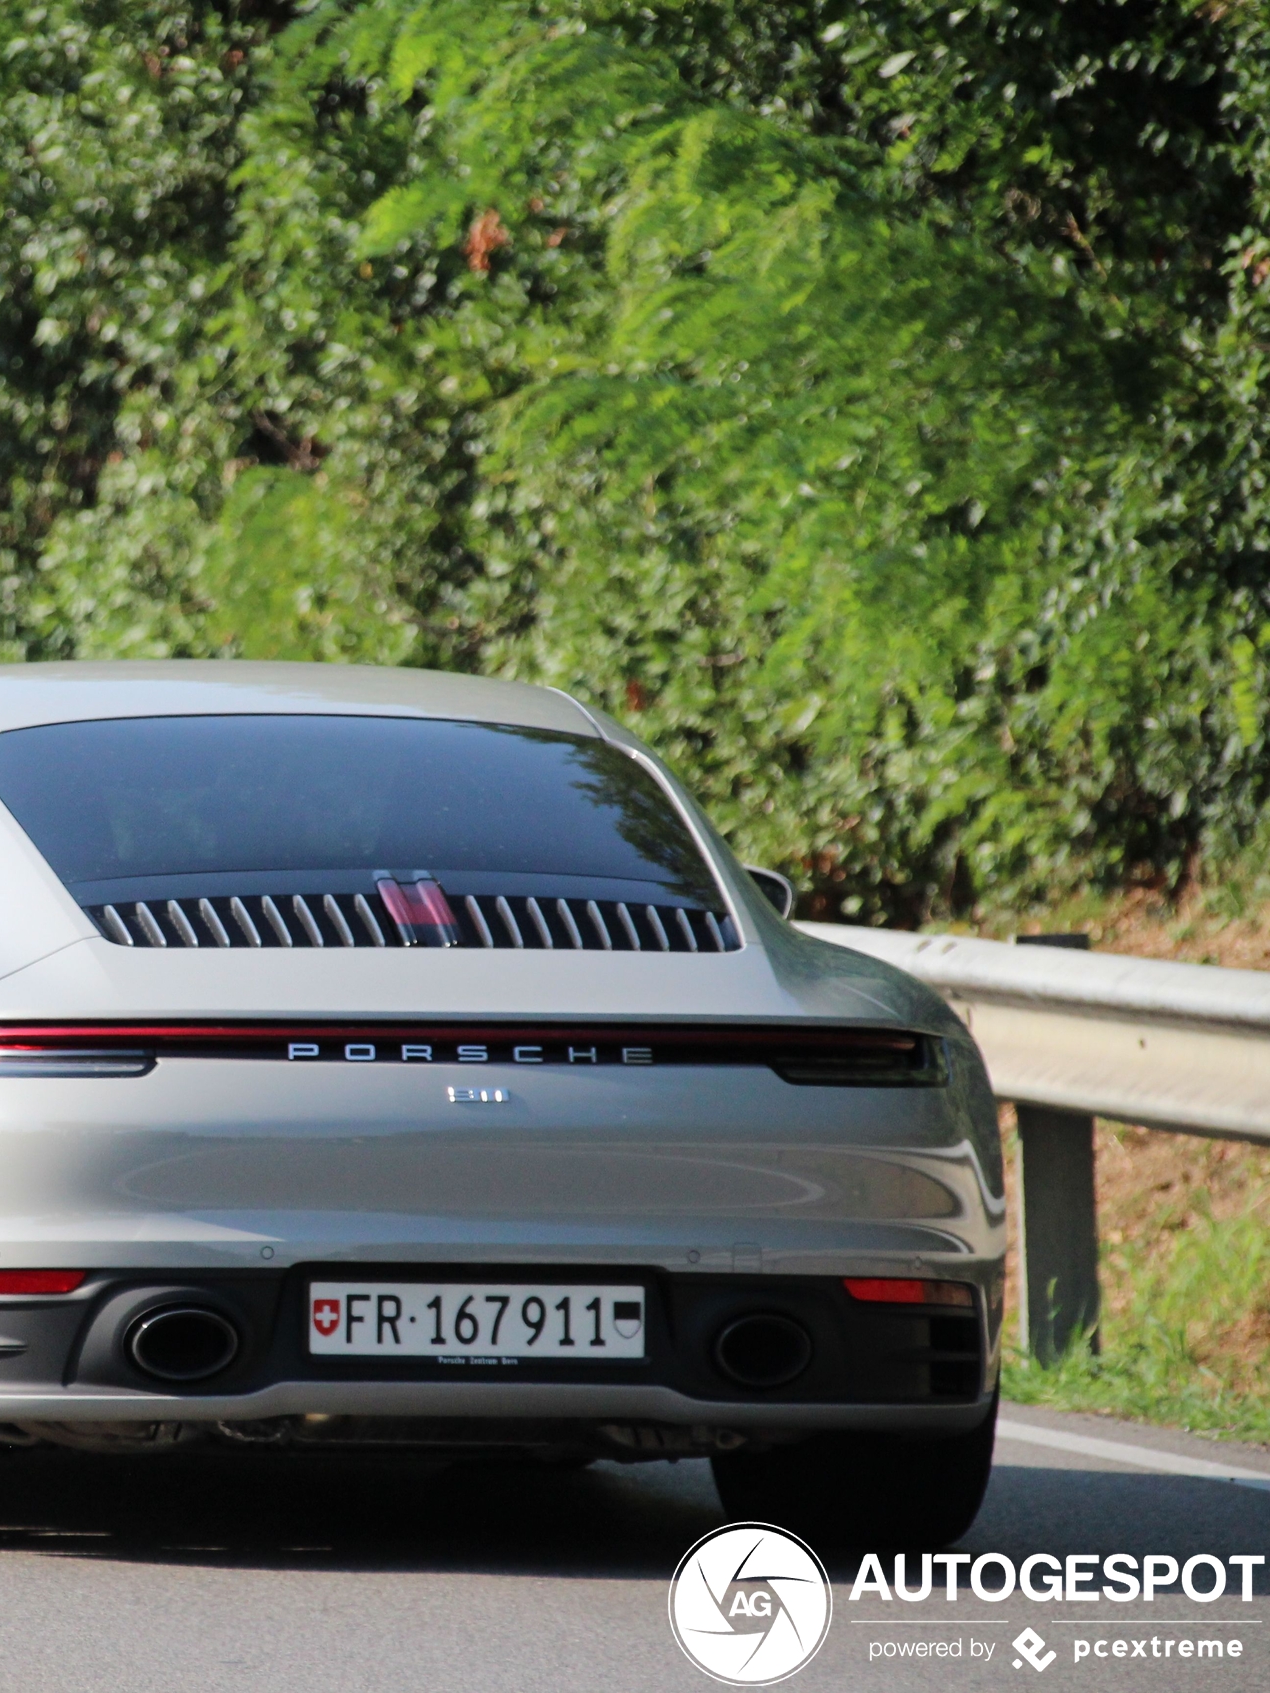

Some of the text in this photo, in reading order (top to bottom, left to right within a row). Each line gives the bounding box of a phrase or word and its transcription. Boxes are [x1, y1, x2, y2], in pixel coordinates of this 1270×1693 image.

[287, 1043, 653, 1064] PORSCHE
[438, 1355, 466, 1365] Porsche
[470, 1356, 498, 1365] Zentrum
